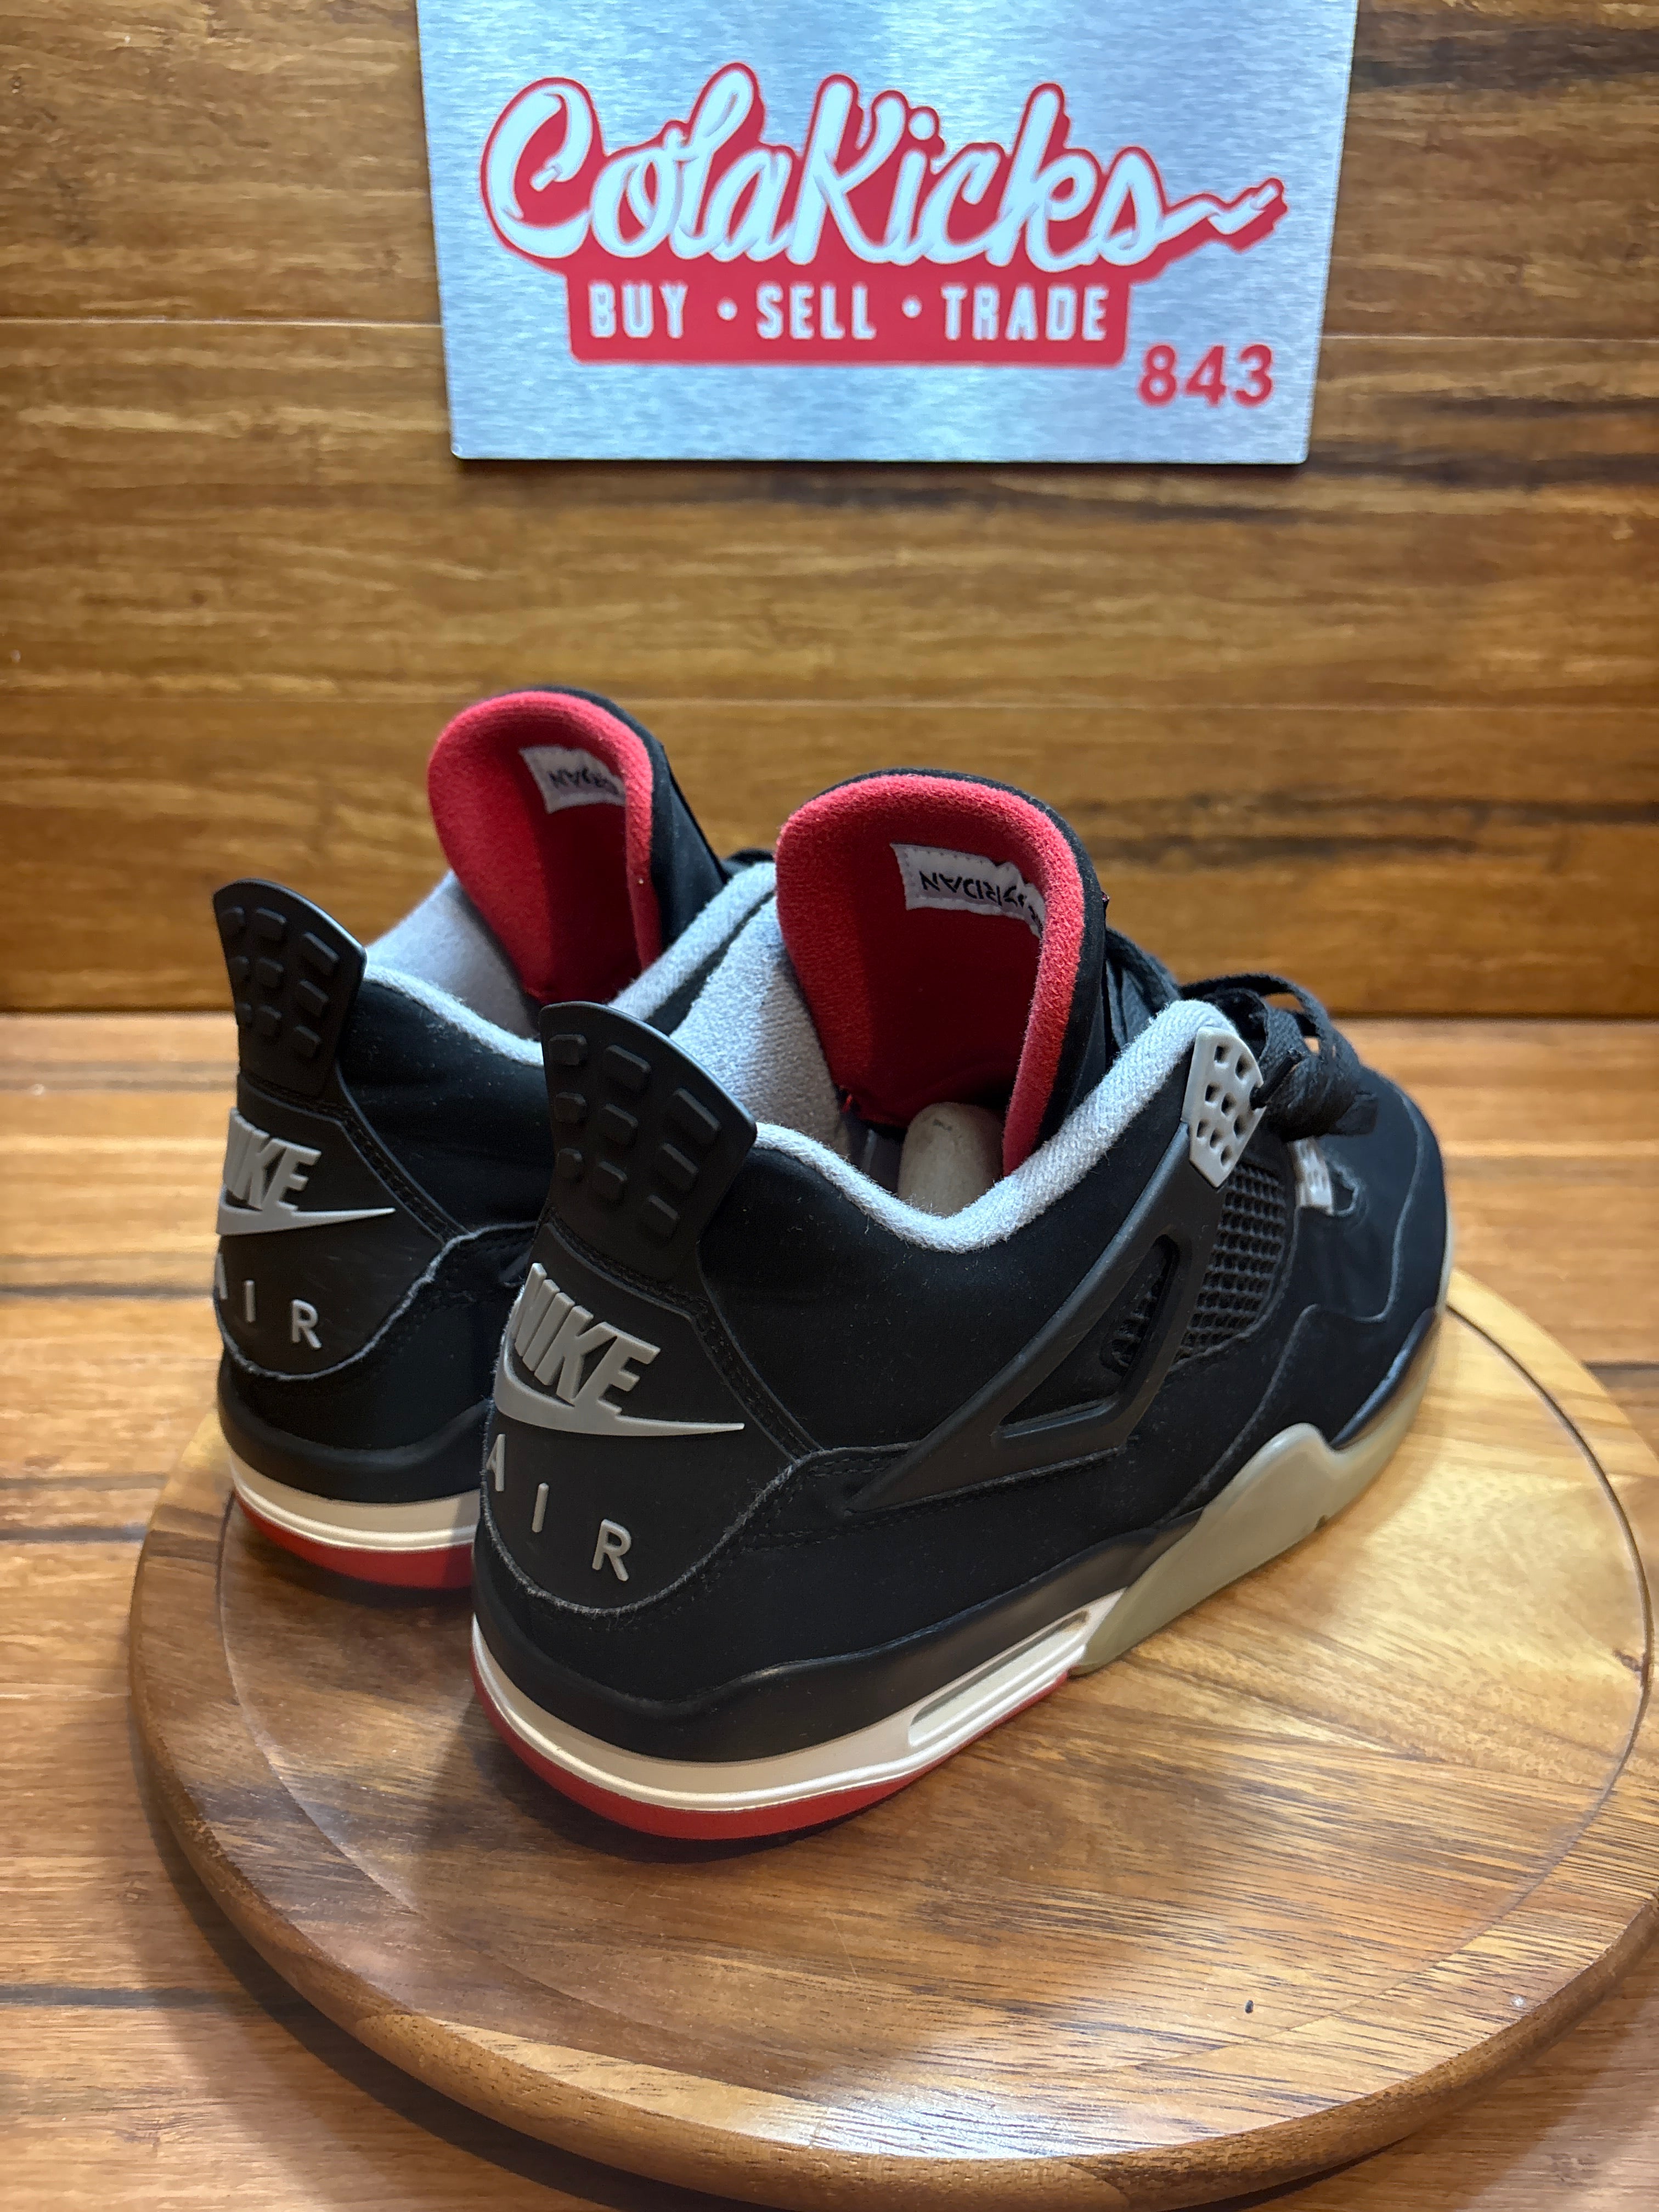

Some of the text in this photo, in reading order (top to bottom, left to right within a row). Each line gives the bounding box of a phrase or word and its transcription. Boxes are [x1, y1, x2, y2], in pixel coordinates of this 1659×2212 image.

[483, 64, 1281, 273] ColaKicks
[588, 280, 1110, 341] BUY SELL TRADE
[1137, 343, 1274, 407] 843
[510, 1262, 661, 1414] NIKE
[486, 1434, 632, 1582] AIR
